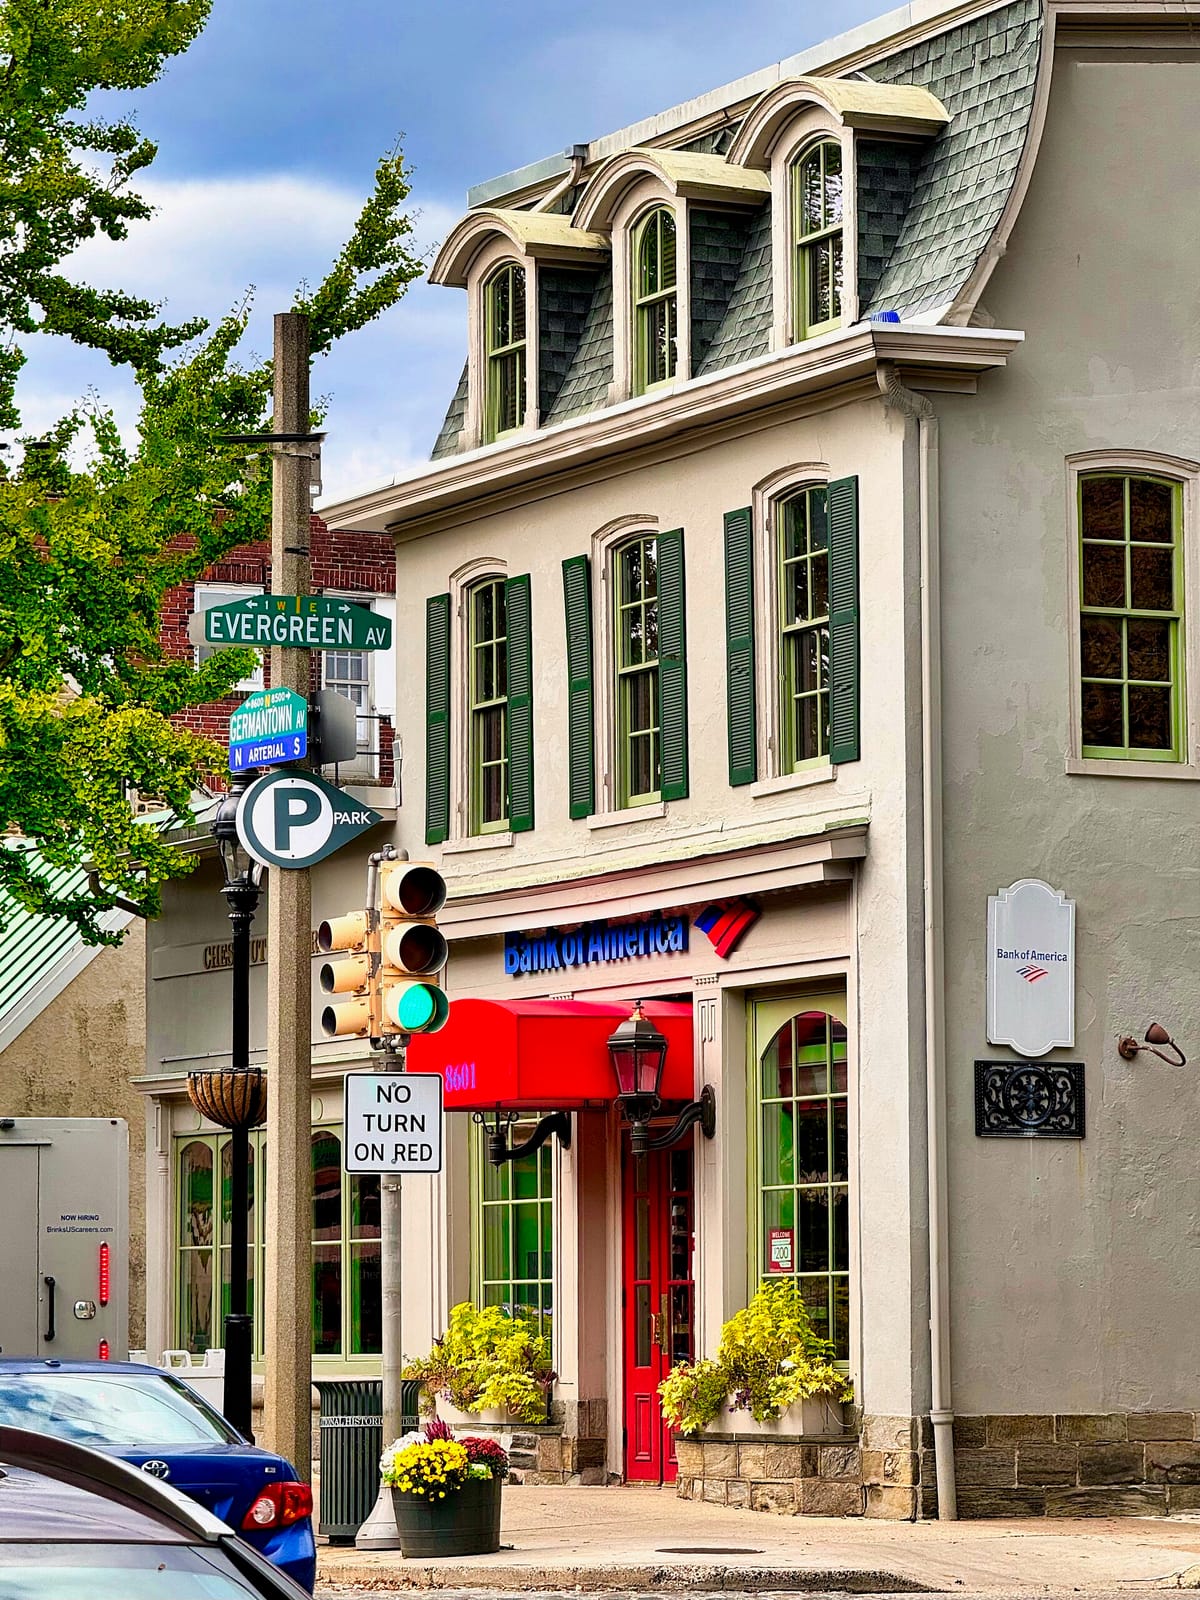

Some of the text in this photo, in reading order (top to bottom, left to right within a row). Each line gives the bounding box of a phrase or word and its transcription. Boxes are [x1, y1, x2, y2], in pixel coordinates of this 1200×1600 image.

[264, 600, 331, 613] 1 W E 1
[210, 612, 387, 646] EVERGREEN AV
[230, 704, 305, 742] GERMANTOWN AV
[235, 736, 301, 767] N ARTERIAL S
[274, 787, 322, 851] P
[333, 811, 372, 825] PARK
[203, 939, 267, 970] CHESUT
[504, 916, 684, 975] Bank of America
[996, 948, 1068, 962] Bank of America
[445, 1062, 476, 1093] 8601
[376, 1085, 412, 1104] NO
[362, 1114, 426, 1133] TURN
[354, 1143, 433, 1162] ON RED
[346, 1416, 384, 1426] HISTORI
